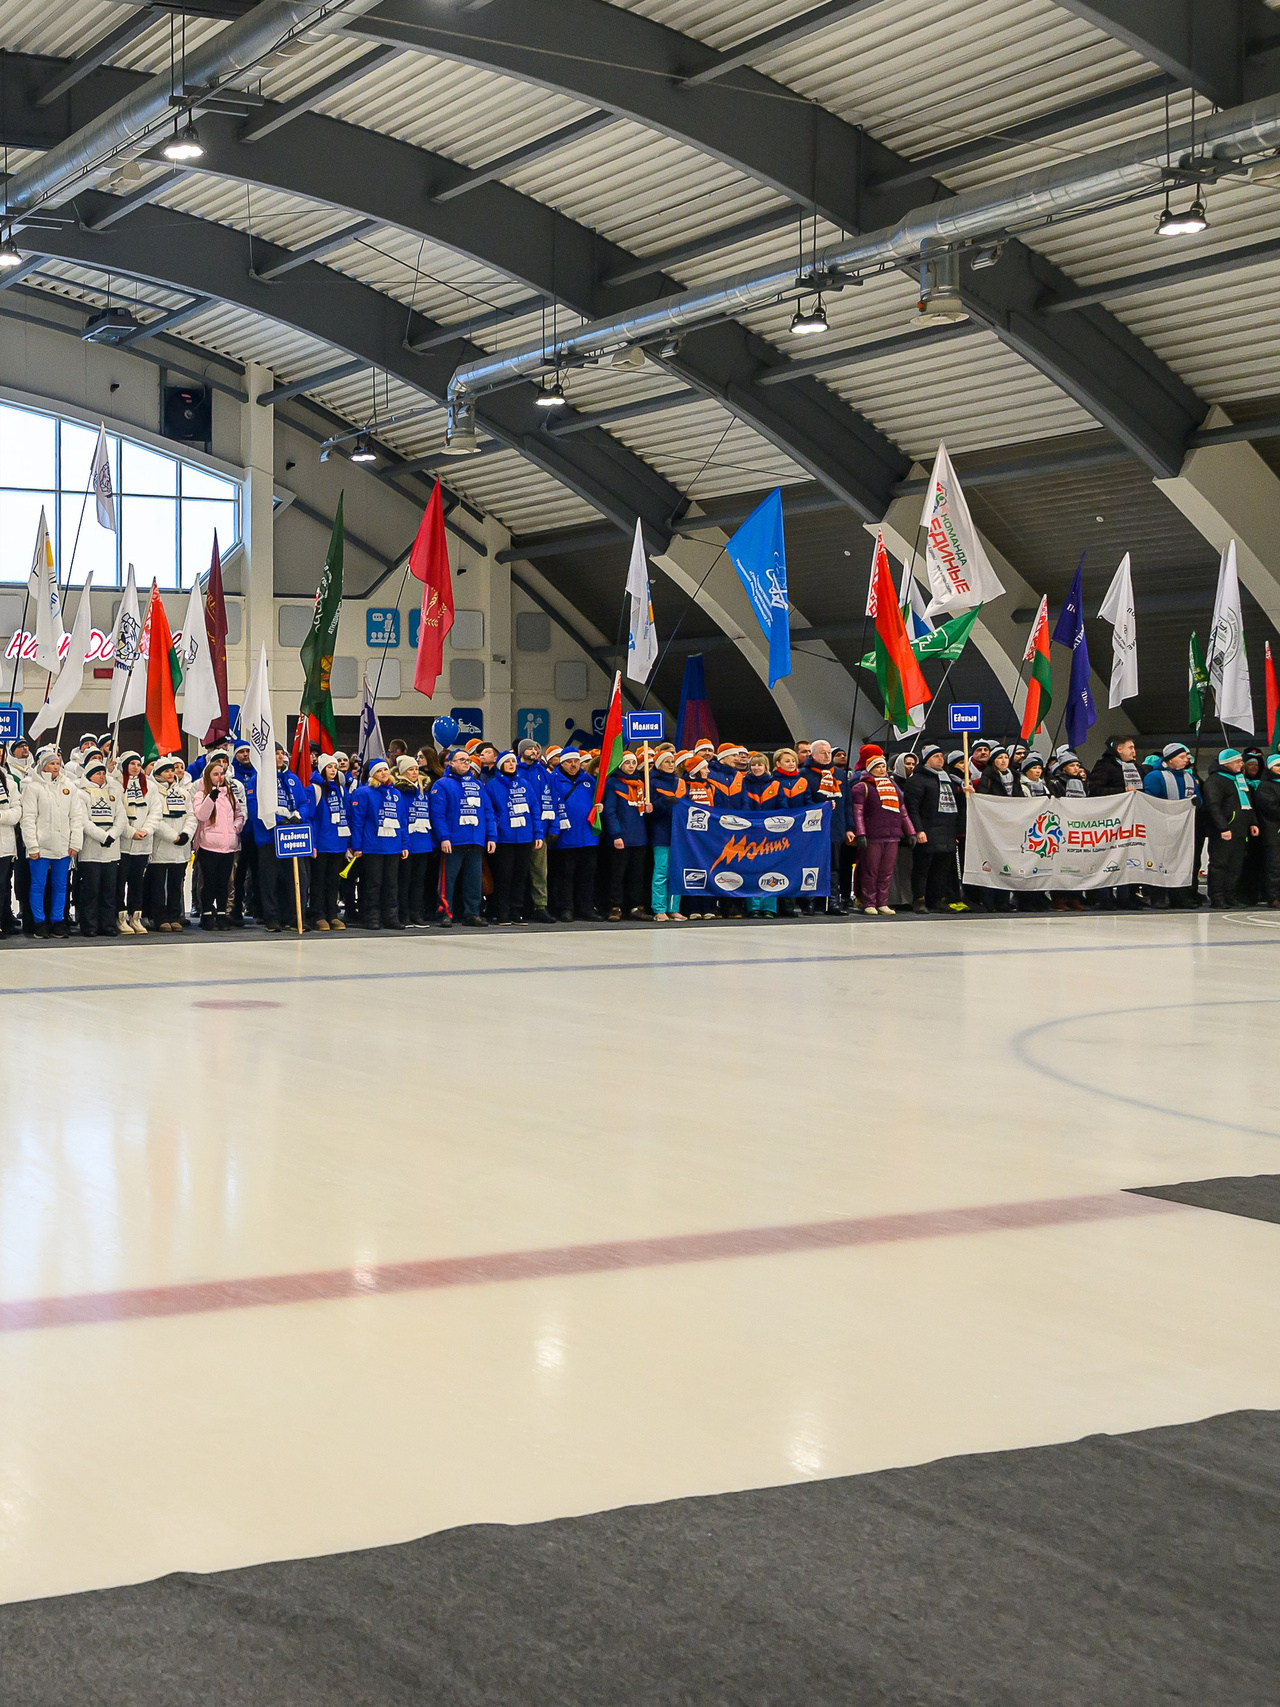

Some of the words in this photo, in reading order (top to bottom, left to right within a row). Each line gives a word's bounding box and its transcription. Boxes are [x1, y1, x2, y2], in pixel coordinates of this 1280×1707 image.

[928, 517, 970, 594] ЕДИНЫЕ
[940, 514, 967, 566] КОМАНДА
[632, 721, 659, 730] Молния
[1067, 817, 1121, 829] КОМАНДА
[1067, 823, 1147, 848] ЕДИНЫЕ
[709, 834, 791, 875] Молния
